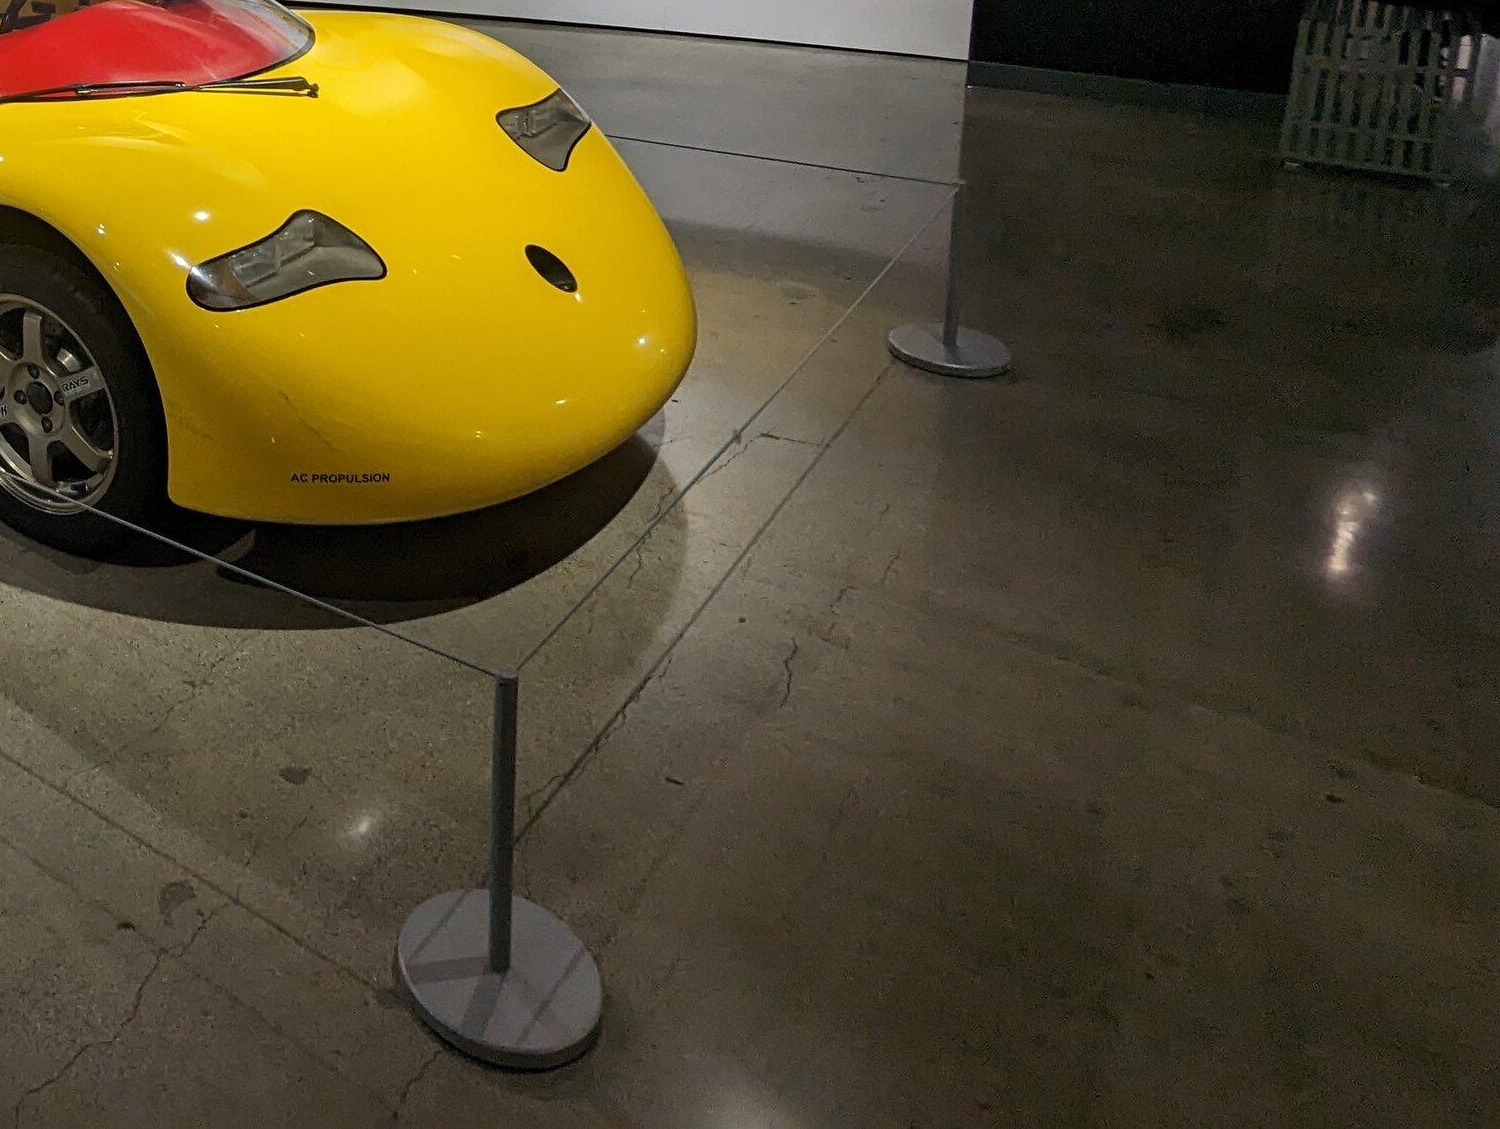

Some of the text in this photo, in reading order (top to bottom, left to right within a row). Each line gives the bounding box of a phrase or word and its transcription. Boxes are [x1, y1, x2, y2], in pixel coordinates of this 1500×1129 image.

[61, 375, 89, 392] RAYS
[290, 472, 391, 484] AC PROPULSION
